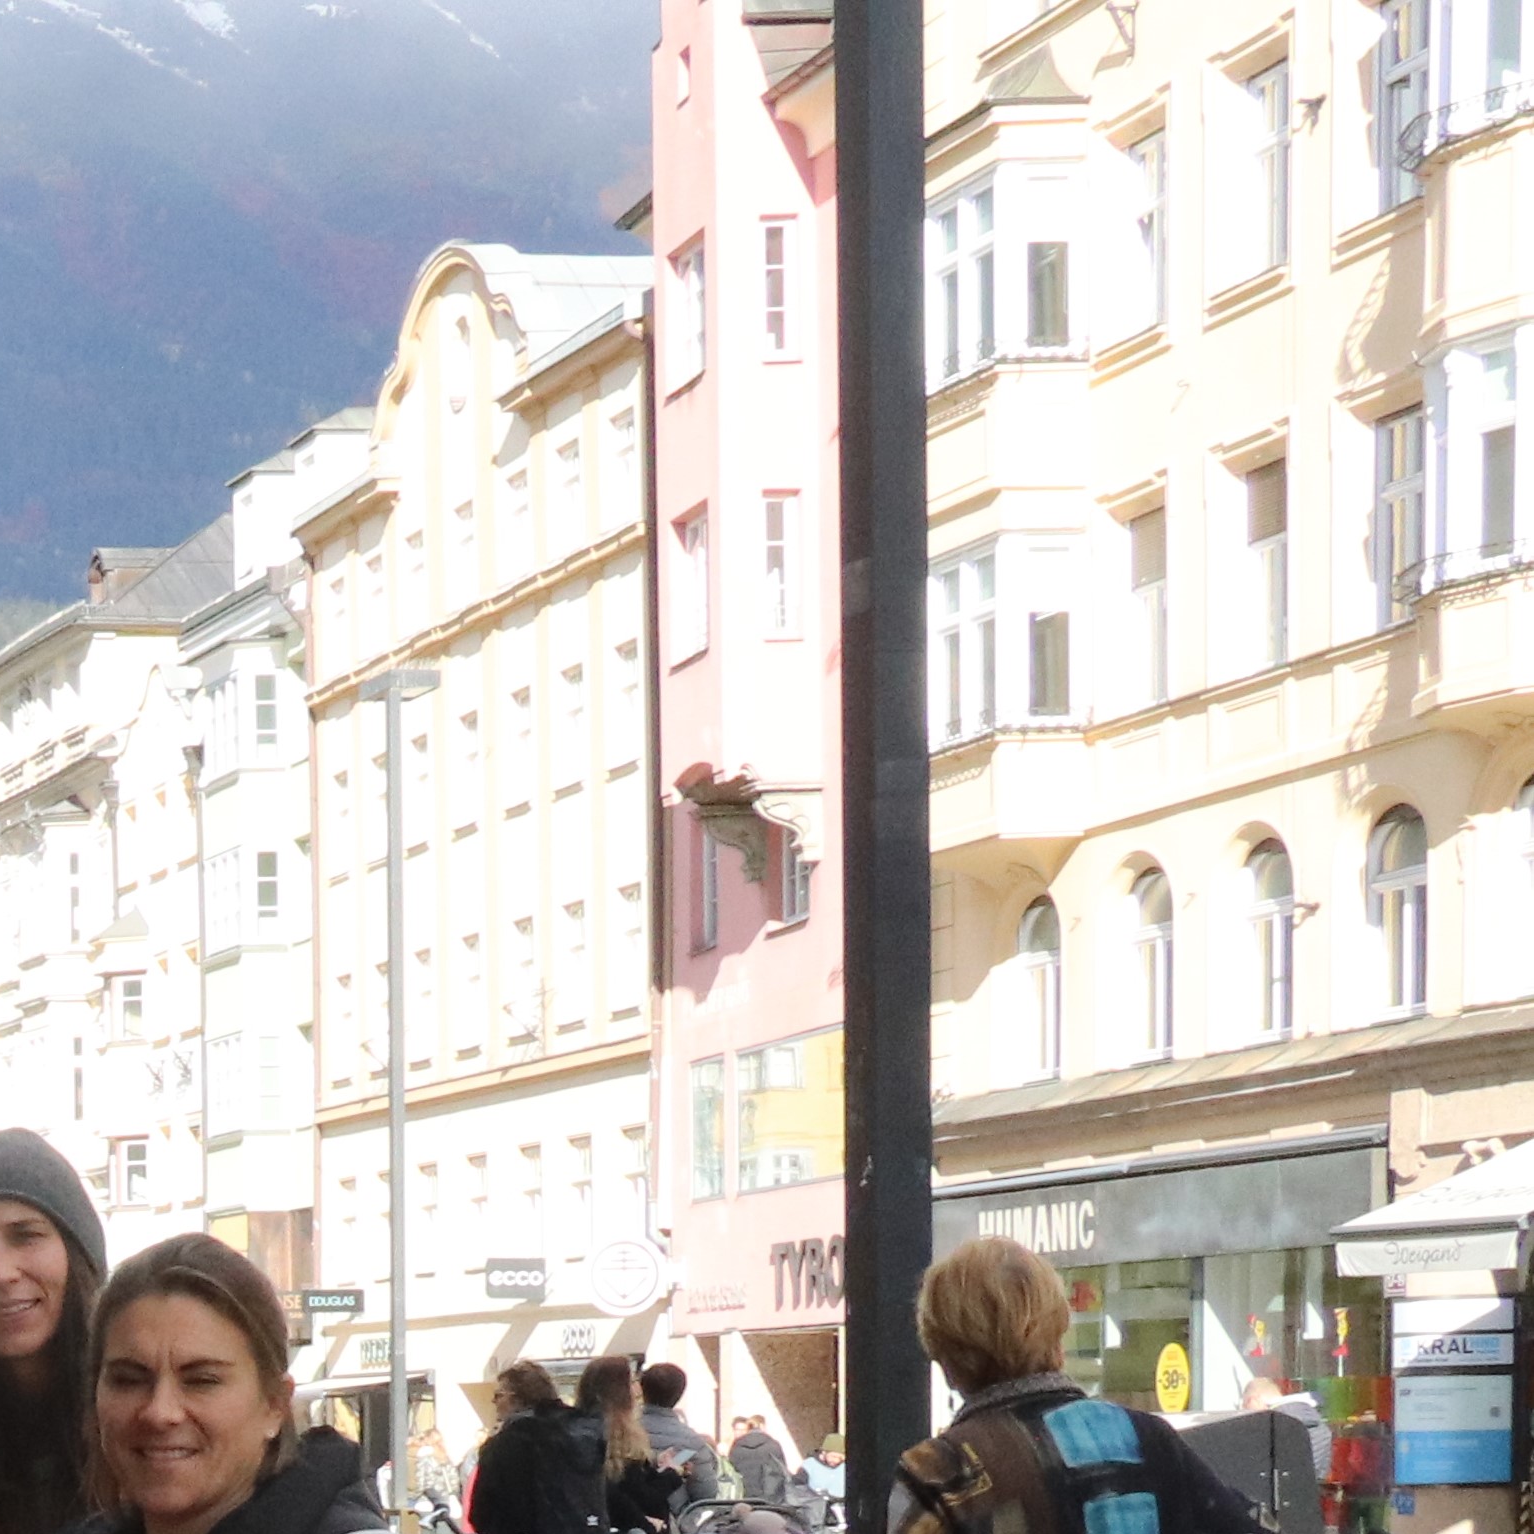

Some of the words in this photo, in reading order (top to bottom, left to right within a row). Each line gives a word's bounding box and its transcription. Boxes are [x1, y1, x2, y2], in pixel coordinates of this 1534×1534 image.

[978, 1199, 1095, 1254] HUMANIC
[488, 1270, 545, 1287] ecco
[309, 1295, 356, 1307] DOUGLAS
[562, 1325, 596, 1352] ecco
[1417, 1337, 1475, 1355] KRAL
